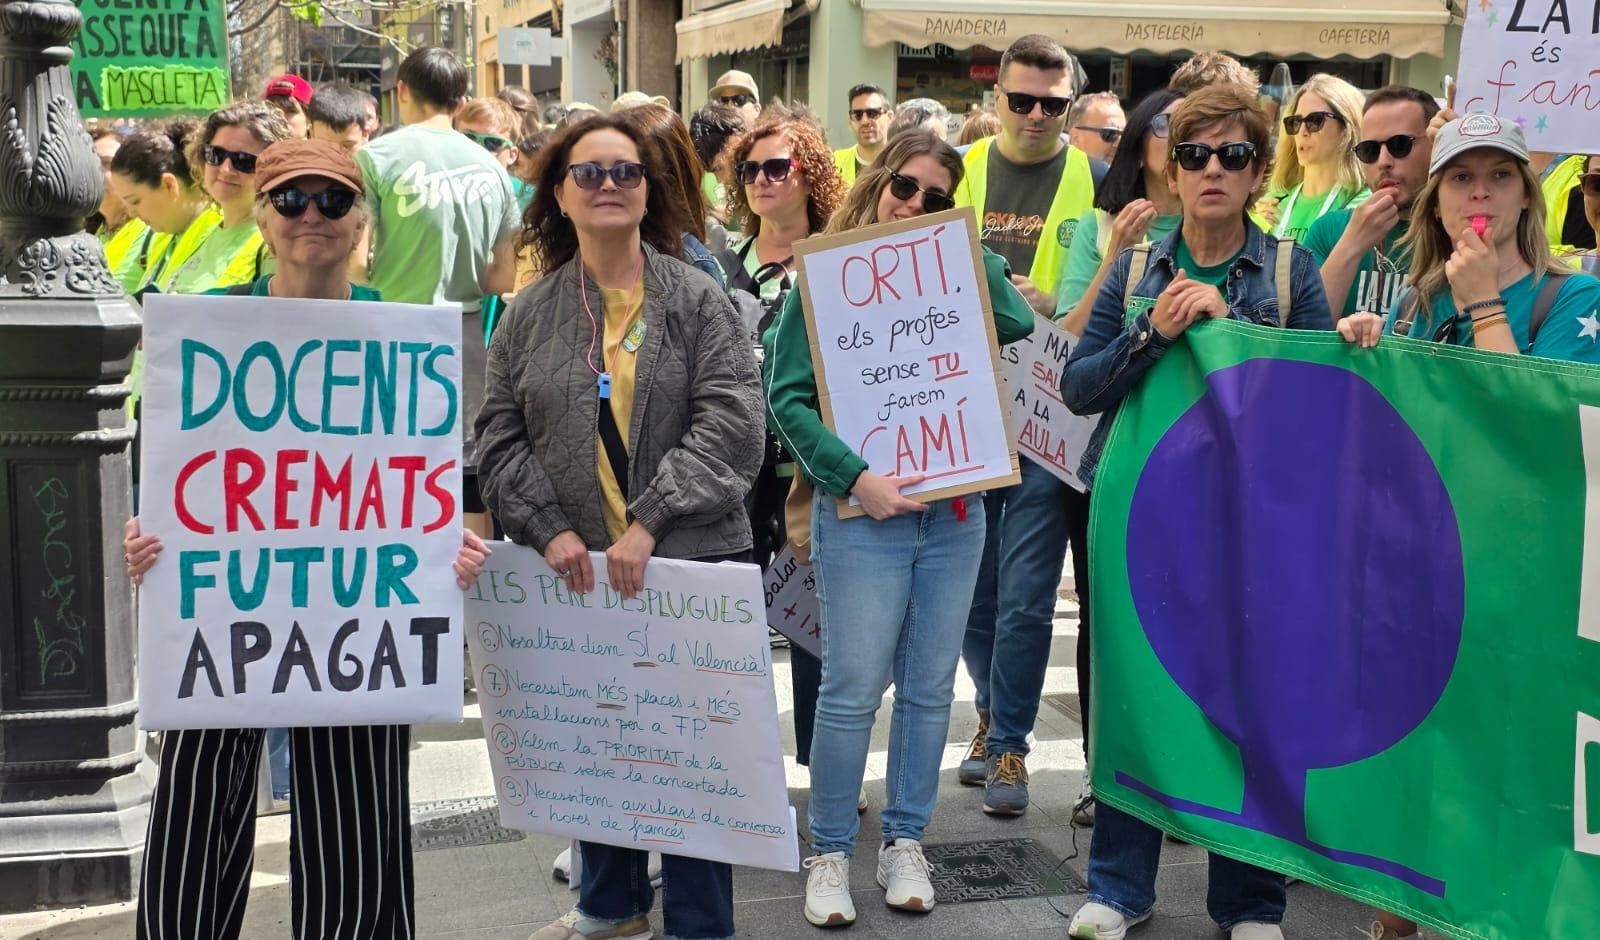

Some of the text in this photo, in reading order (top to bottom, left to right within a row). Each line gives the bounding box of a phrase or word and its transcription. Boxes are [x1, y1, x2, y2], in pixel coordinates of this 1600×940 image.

[196, 16, 218, 58] A
[1530, 39, 1562, 63] és
[106, 69, 221, 107] MASCLETA
[1465, 59, 1600, 117] fan
[837, 306, 961, 353] els profes
[180, 338, 458, 438] DOCENTS
[861, 351, 963, 386] sense TU
[877, 387, 946, 422] farem
[1015, 387, 1050, 424] A LA
[859, 396, 967, 478] CAMÍ
[1020, 418, 1067, 466] AULA
[174, 447, 458, 536] CREMATS
[179, 542, 421, 620] FUTUR
[177, 616, 450, 700] APAGAT
[581, 632, 625, 657] diem
[627, 623, 650, 658] SÍ
[657, 642, 681, 665] al
[596, 677, 628, 702] MÉS
[635, 688, 682, 717] places
[707, 690, 743, 717] MÉS
[516, 729, 567, 752] Volem
[573, 736, 598, 756] la
[596, 740, 685, 765] PRIORITAT
[684, 754, 702, 770] de
[706, 755, 729, 772] la
[615, 718, 646, 742] per
[651, 722, 669, 735] a
[574, 760, 616, 779] sobre
[623, 763, 650, 784] la
[549, 804, 591, 826] hores
[600, 815, 622, 831] de
[701, 808, 725, 826] de
